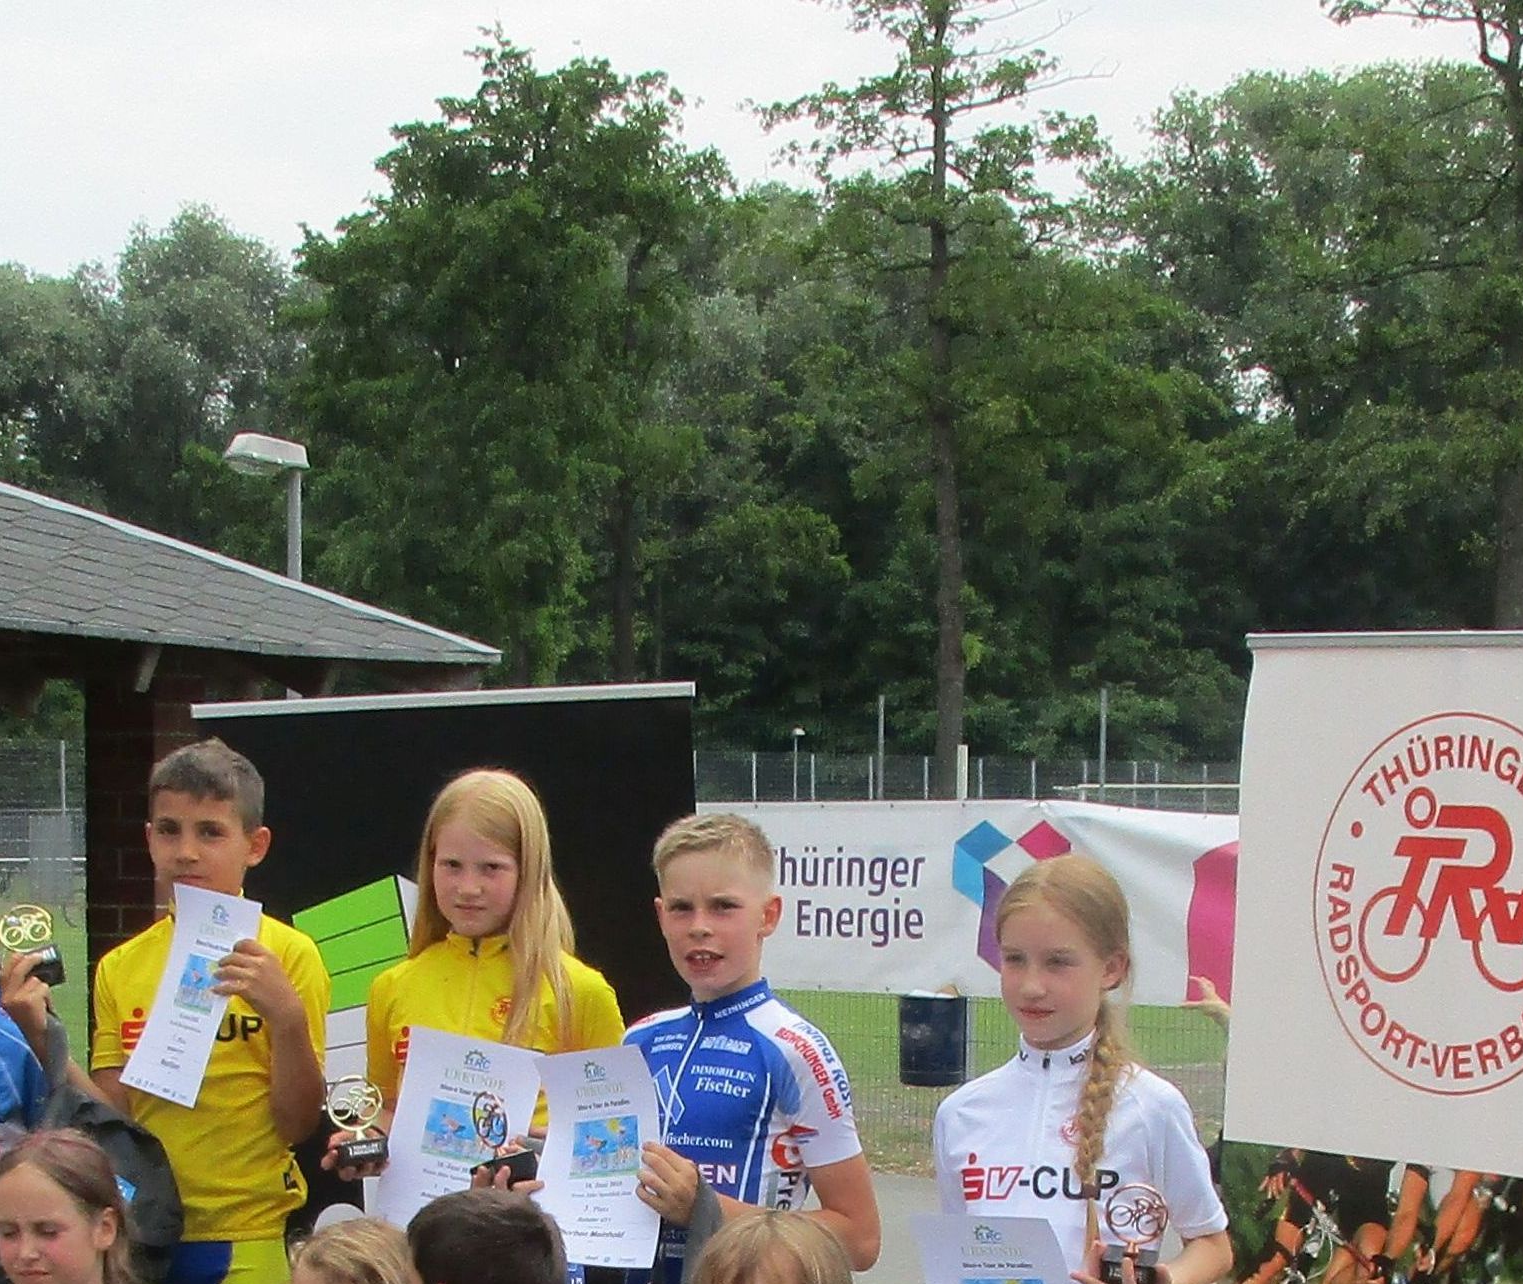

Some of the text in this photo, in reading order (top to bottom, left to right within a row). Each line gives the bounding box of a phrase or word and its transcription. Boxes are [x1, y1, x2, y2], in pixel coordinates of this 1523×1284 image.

[775, 846, 926, 896] hüringer
[795, 898, 925, 947] Energie
[694, 1076, 751, 1099] Fischer
[665, 1132, 734, 1149] fischer.com
[699, 1163, 737, 1185] EN
